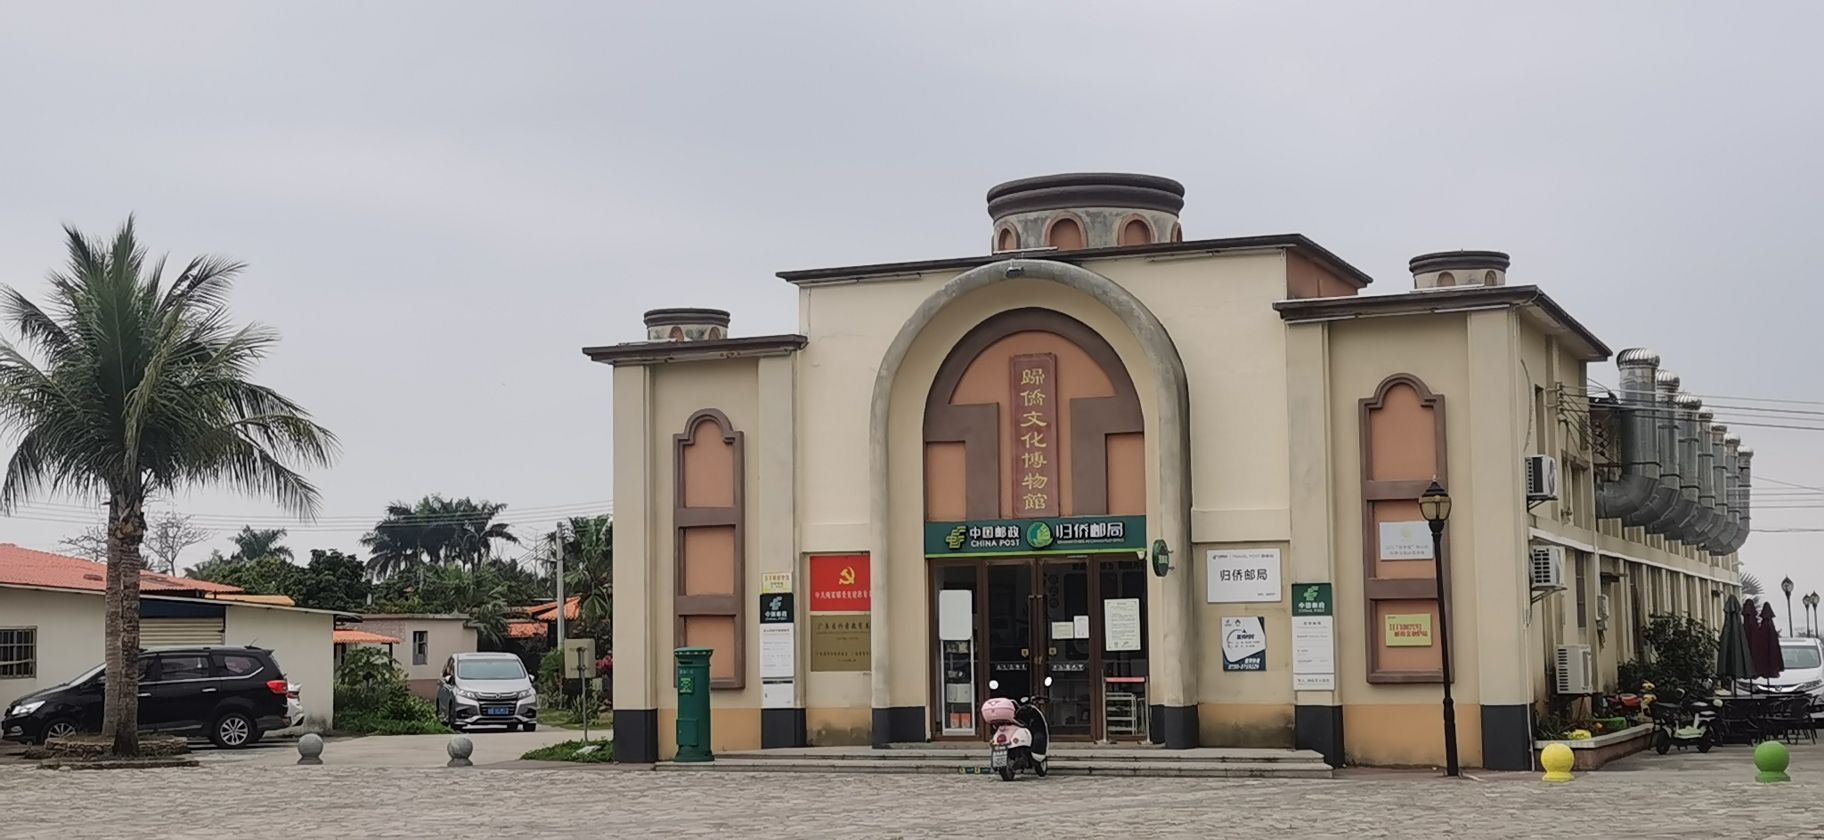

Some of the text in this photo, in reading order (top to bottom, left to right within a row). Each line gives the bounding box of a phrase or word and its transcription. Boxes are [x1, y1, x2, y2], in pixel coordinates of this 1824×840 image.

[1020, 368, 1048, 510] 歸僑文化博物館
[969, 525, 1020, 539] 中国邮政
[1056, 522, 1123, 538] 归侨邮局
[970, 538, 1020, 547] CHINA POST
[1219, 568, 1268, 581] 归侨邮局
